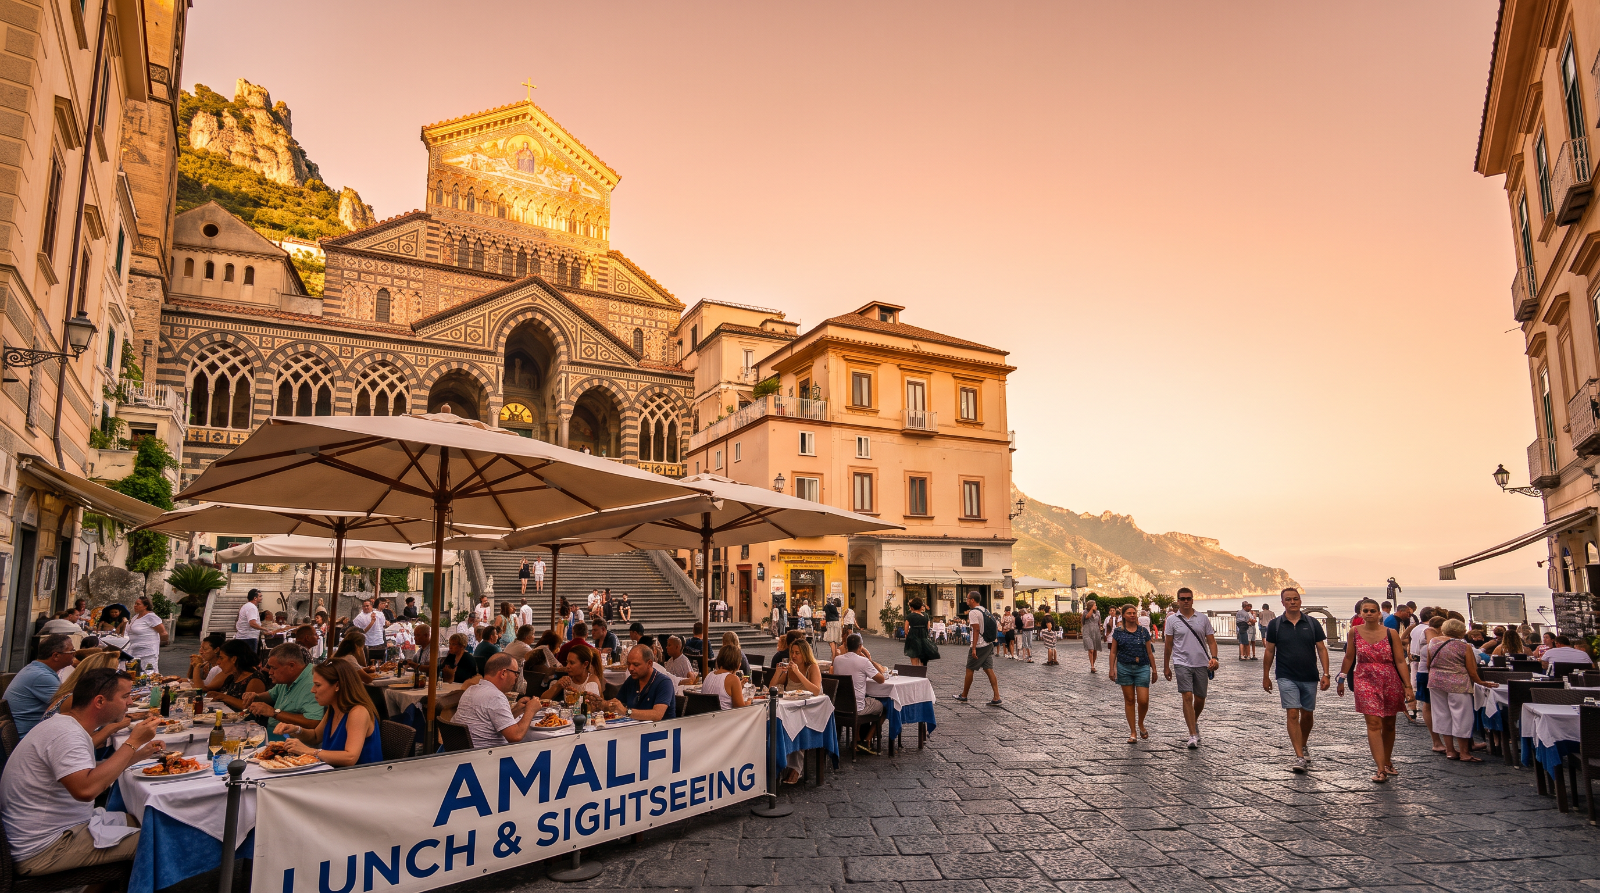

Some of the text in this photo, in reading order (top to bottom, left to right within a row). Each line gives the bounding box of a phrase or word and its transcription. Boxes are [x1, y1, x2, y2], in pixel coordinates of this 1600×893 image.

[433, 728, 681, 827] AMALFI
[492, 821, 522, 858] &
[537, 763, 755, 847] SIGHTSEEING
